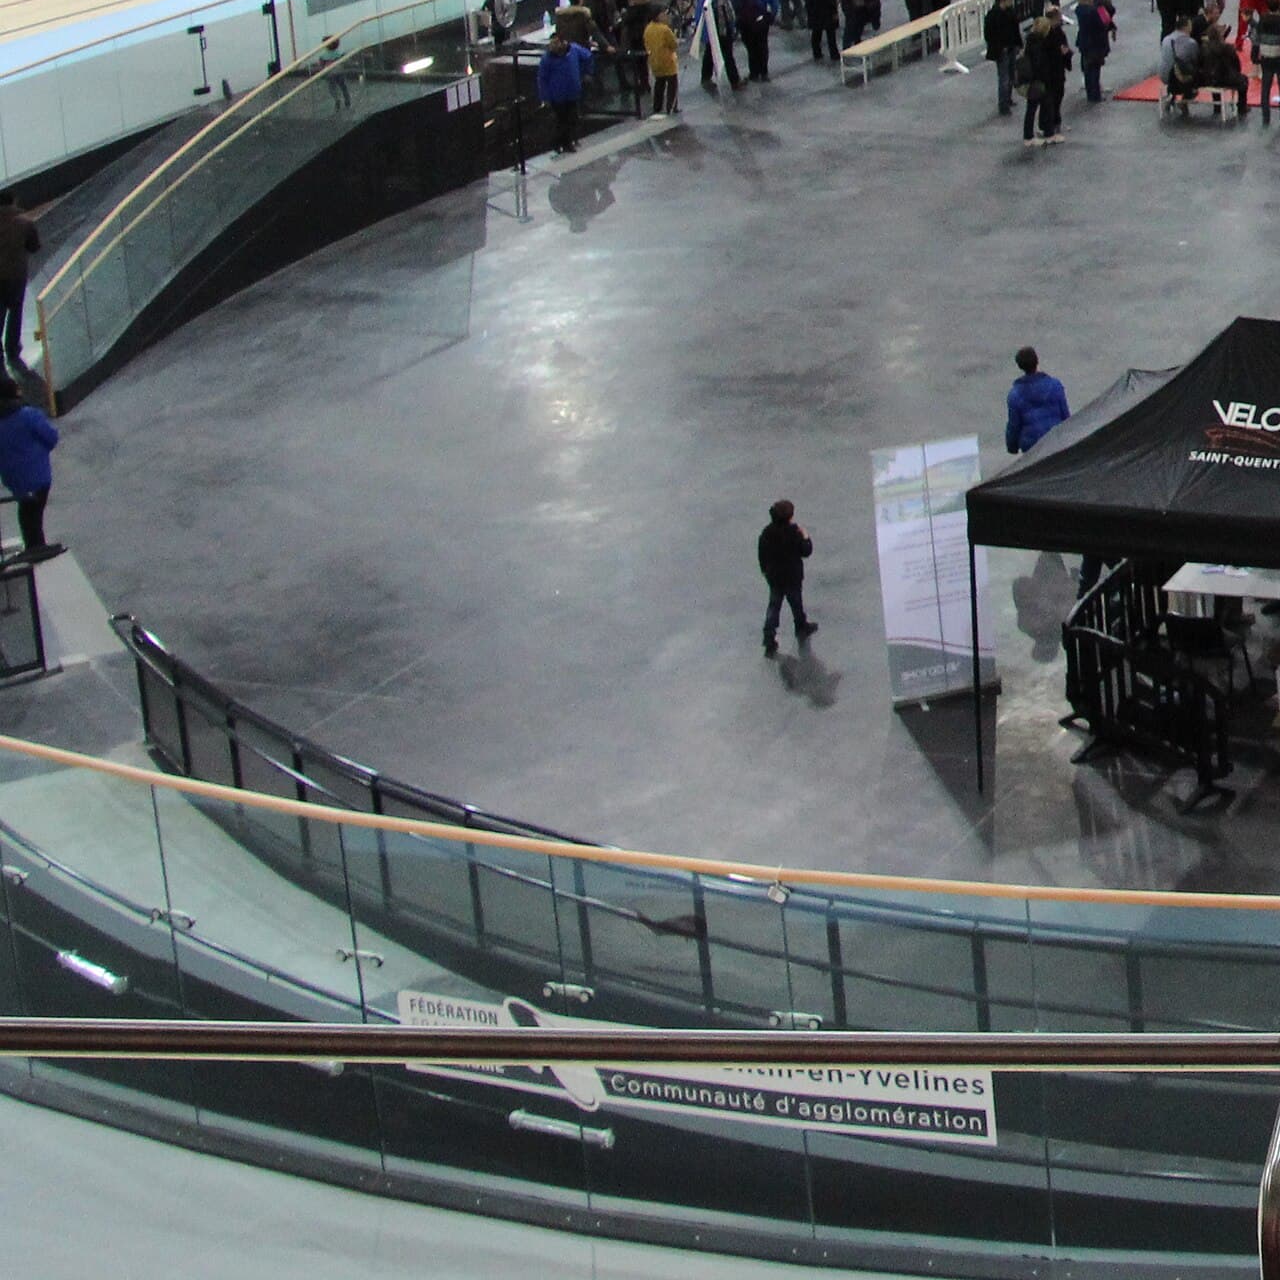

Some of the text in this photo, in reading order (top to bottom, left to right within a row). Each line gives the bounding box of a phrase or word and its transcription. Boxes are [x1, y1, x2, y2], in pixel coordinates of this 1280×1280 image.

[410, 996, 498, 1026] FÉDÉRATION
[611, 1073, 983, 1132] Communauté d'agglomération
